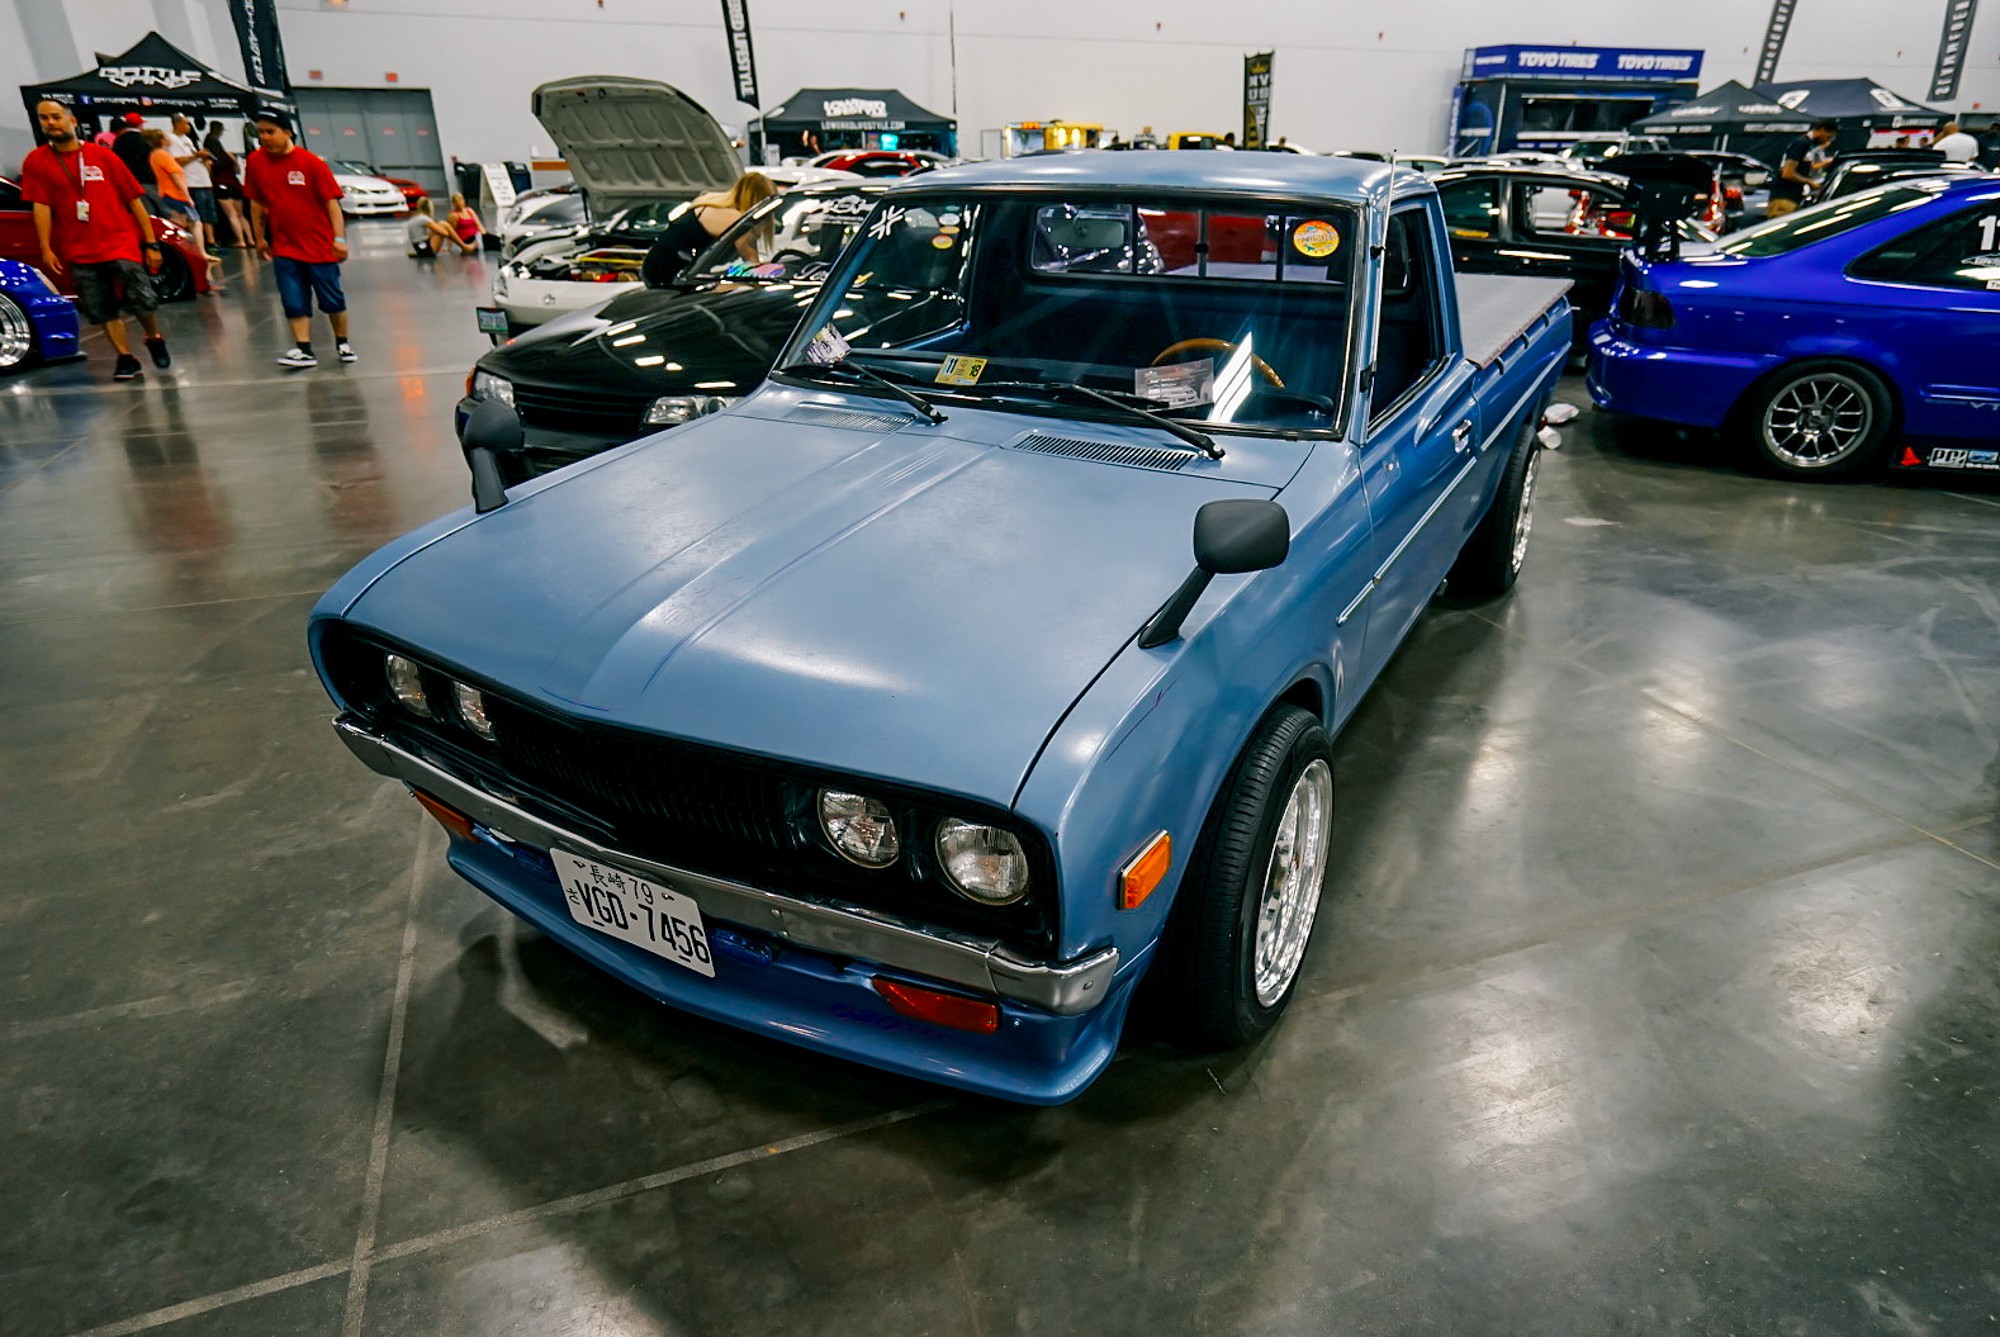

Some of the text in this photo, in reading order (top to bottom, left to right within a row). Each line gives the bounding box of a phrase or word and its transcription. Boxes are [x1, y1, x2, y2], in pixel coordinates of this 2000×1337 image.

[1519, 52, 1557, 67] TOYO
[1557, 53, 1599, 68] TIRES
[1618, 55, 1693, 70] TOYO TIRES
[1978, 215, 2000, 251] 1
[969, 364, 982, 377] 18
[590, 864, 655, 905] 長崎 79
